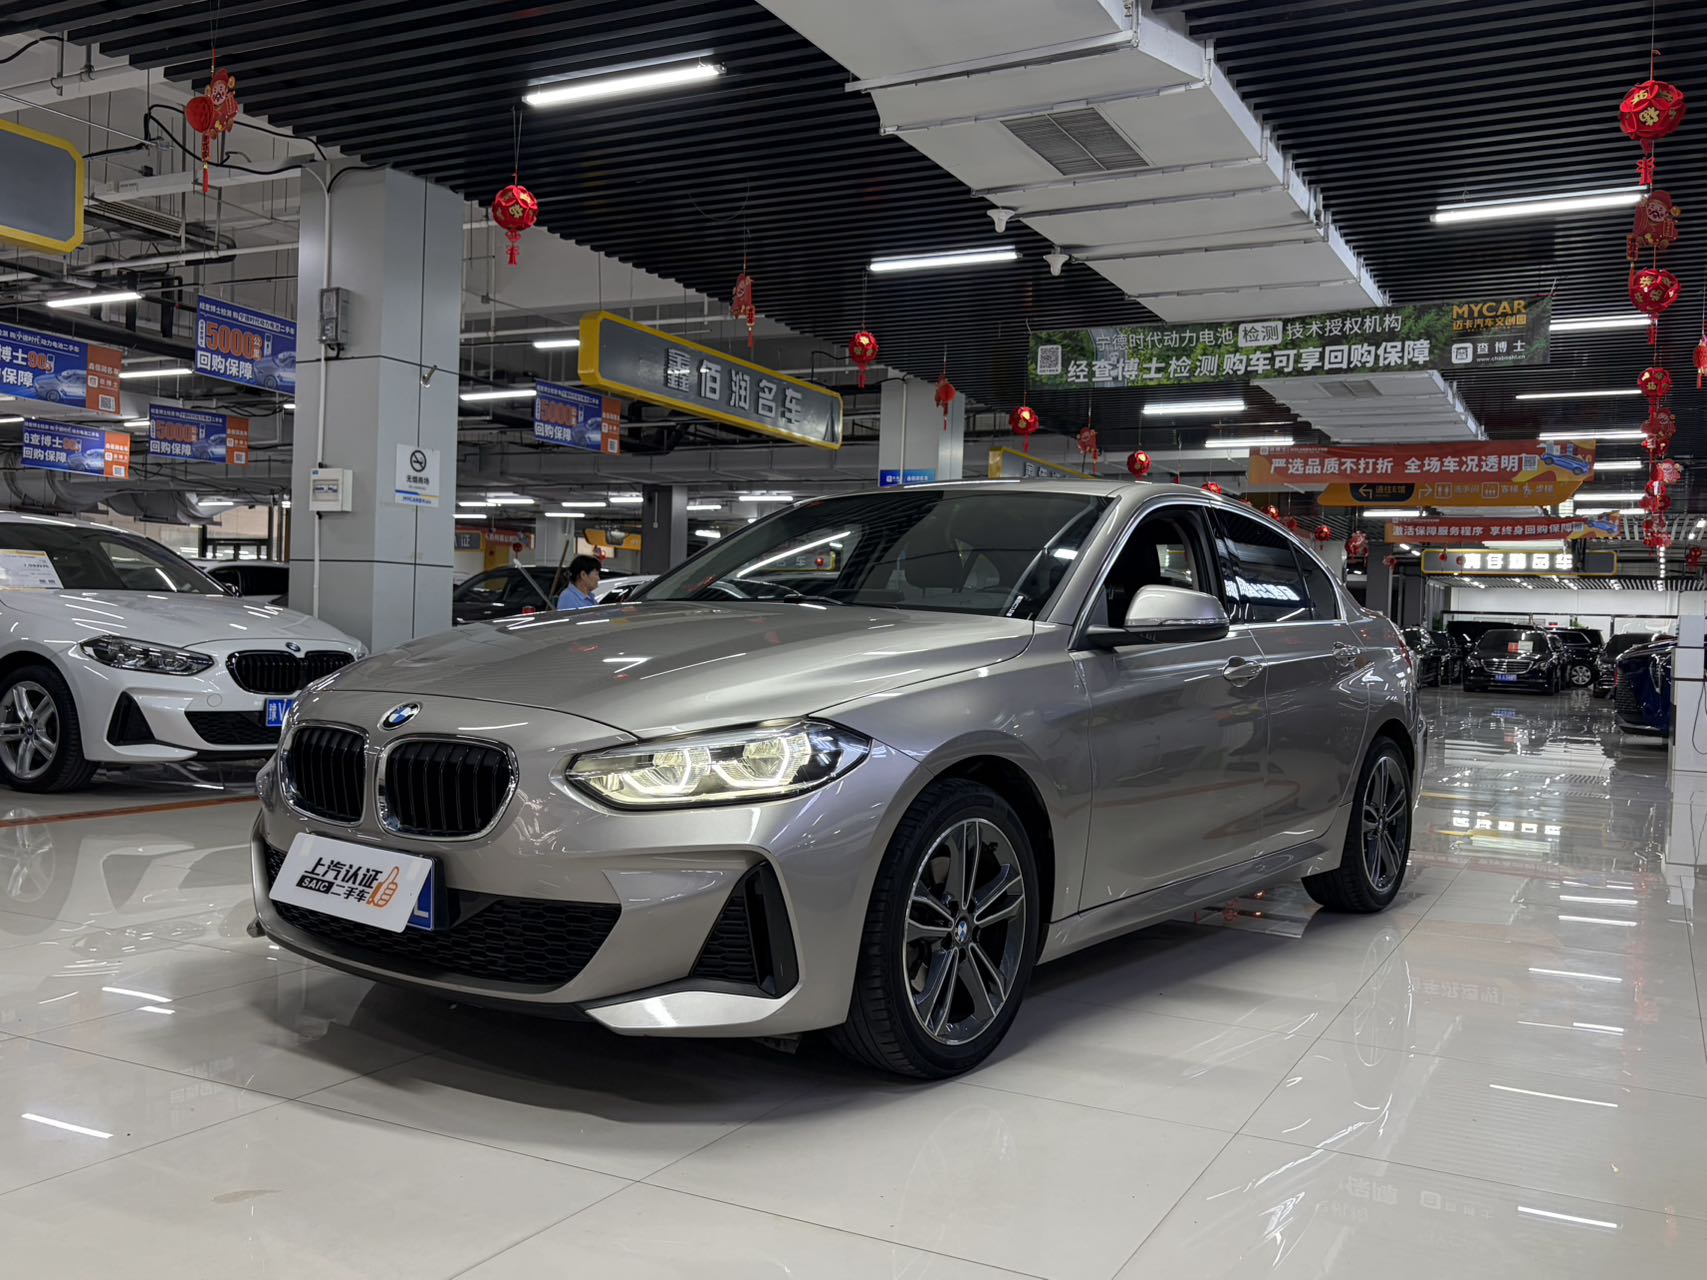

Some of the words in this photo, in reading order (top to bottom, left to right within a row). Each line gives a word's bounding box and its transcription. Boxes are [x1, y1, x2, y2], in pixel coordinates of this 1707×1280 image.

[1452, 300, 1526, 319] MYCAR
[206, 321, 253, 360] 5000
[1095, 326, 1234, 351] 宁德时代动力电池
[1242, 324, 1280, 343] 检测
[1286, 313, 1402, 340] 技术授权机构
[1477, 340, 1526, 354] 查博士
[0, 366, 33, 387] 保障
[197, 350, 252, 380] 回购保障
[667, 348, 802, 424] 鑫佰润名车
[23, 447, 67, 463] 回购保障
[150, 440, 192, 456] 回购保障
[1270, 457, 1394, 475] 严选品质不打折
[1404, 454, 1521, 474] 全场车况透明
[304, 857, 383, 889] 上汽认证
[300, 876, 330, 892] SAIC
[330, 883, 370, 903] 二手车
